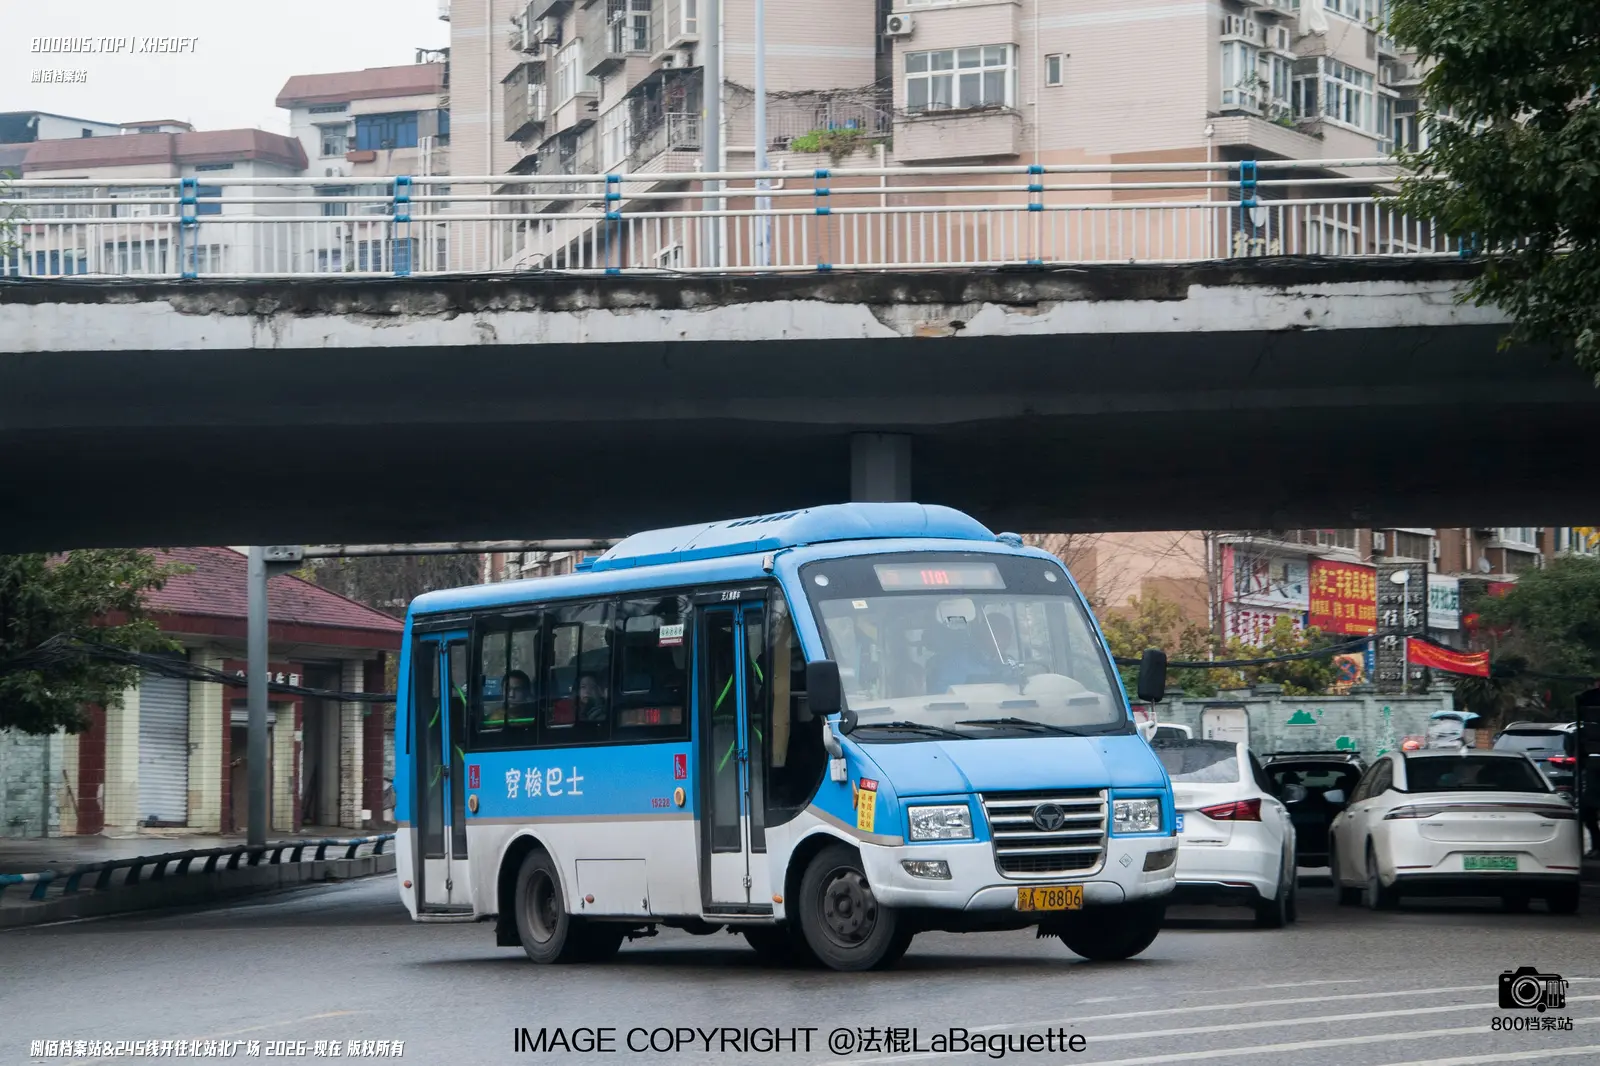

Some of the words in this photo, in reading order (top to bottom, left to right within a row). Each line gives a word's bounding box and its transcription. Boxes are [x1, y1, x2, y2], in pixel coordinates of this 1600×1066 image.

[920, 569, 950, 586] 1101
[505, 766, 584, 798] 穿梭巴士
